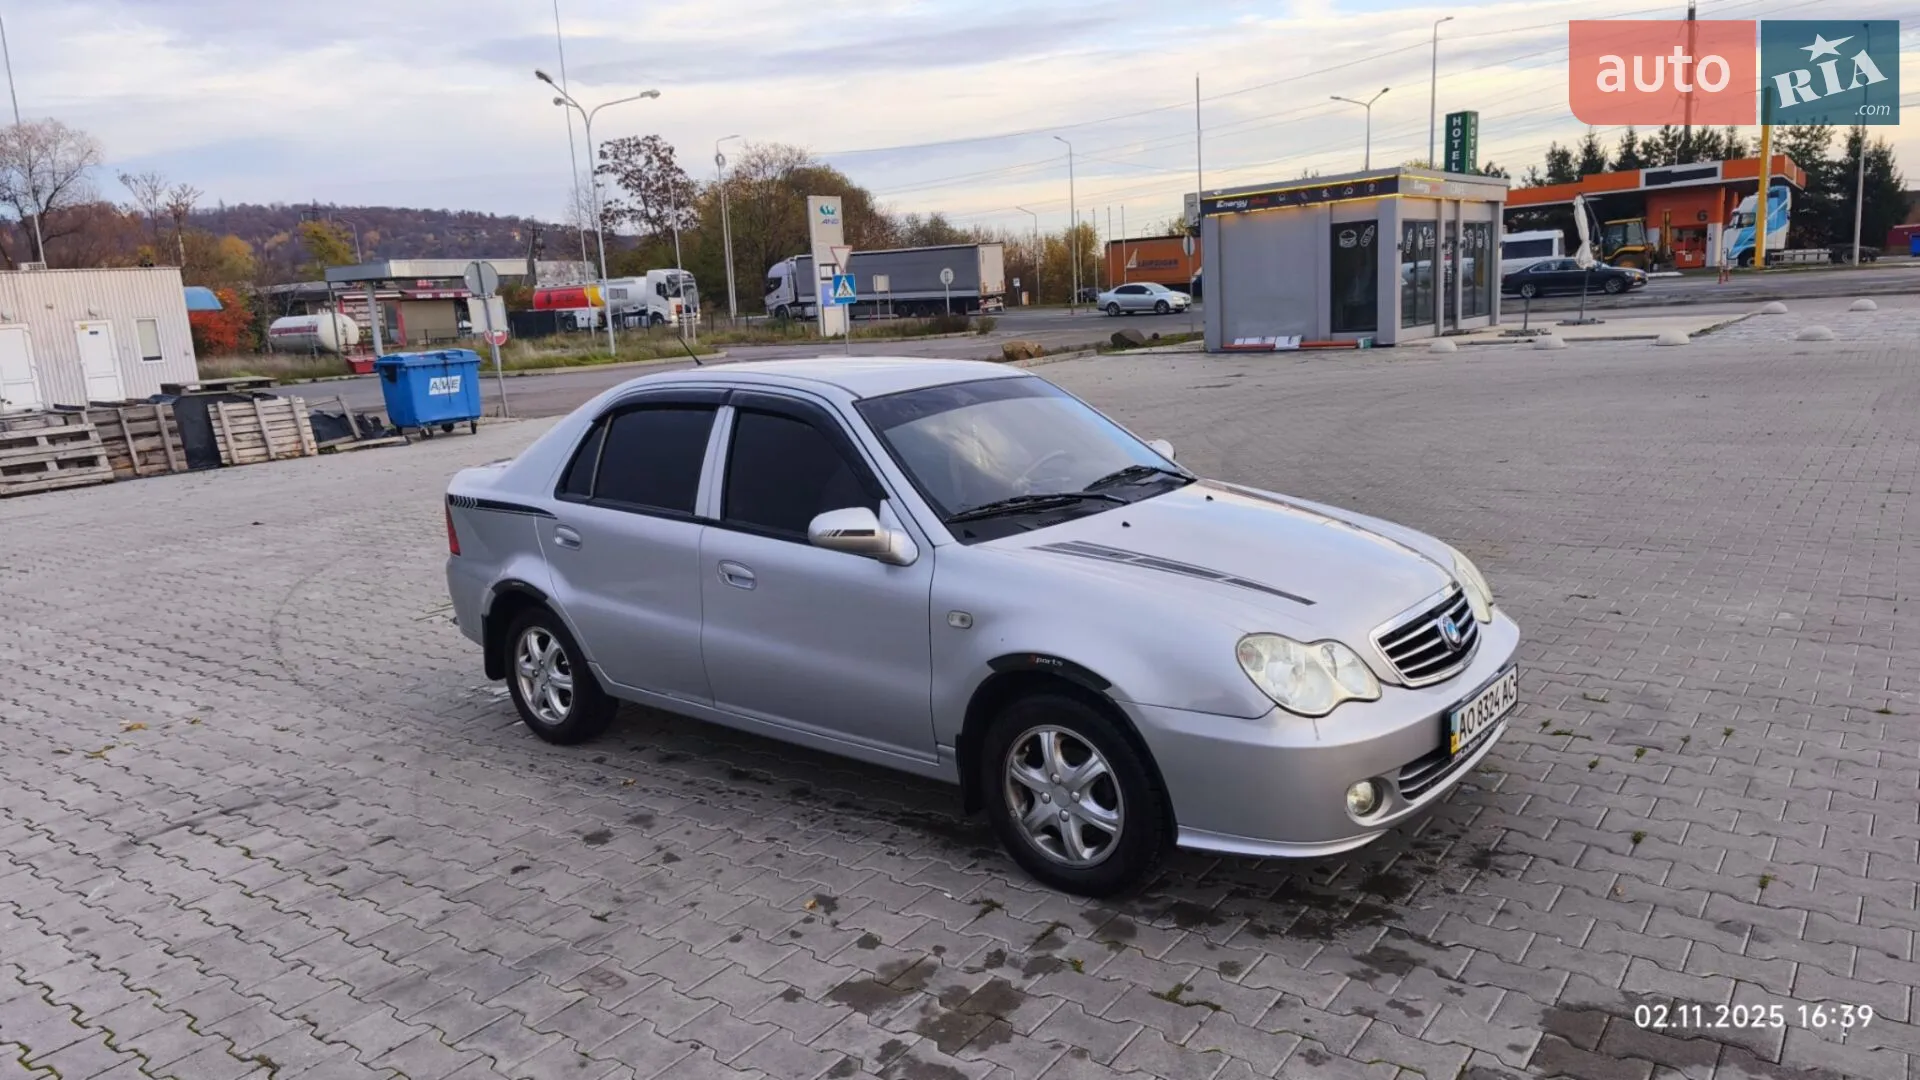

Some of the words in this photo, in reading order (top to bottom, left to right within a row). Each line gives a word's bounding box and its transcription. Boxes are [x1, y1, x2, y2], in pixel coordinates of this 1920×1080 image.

[1452, 115, 1461, 171] HOTEL
[1459, 707, 1475, 741] AO
[1477, 686, 1500, 726] 8324
[1502, 674, 1515, 707] AC
